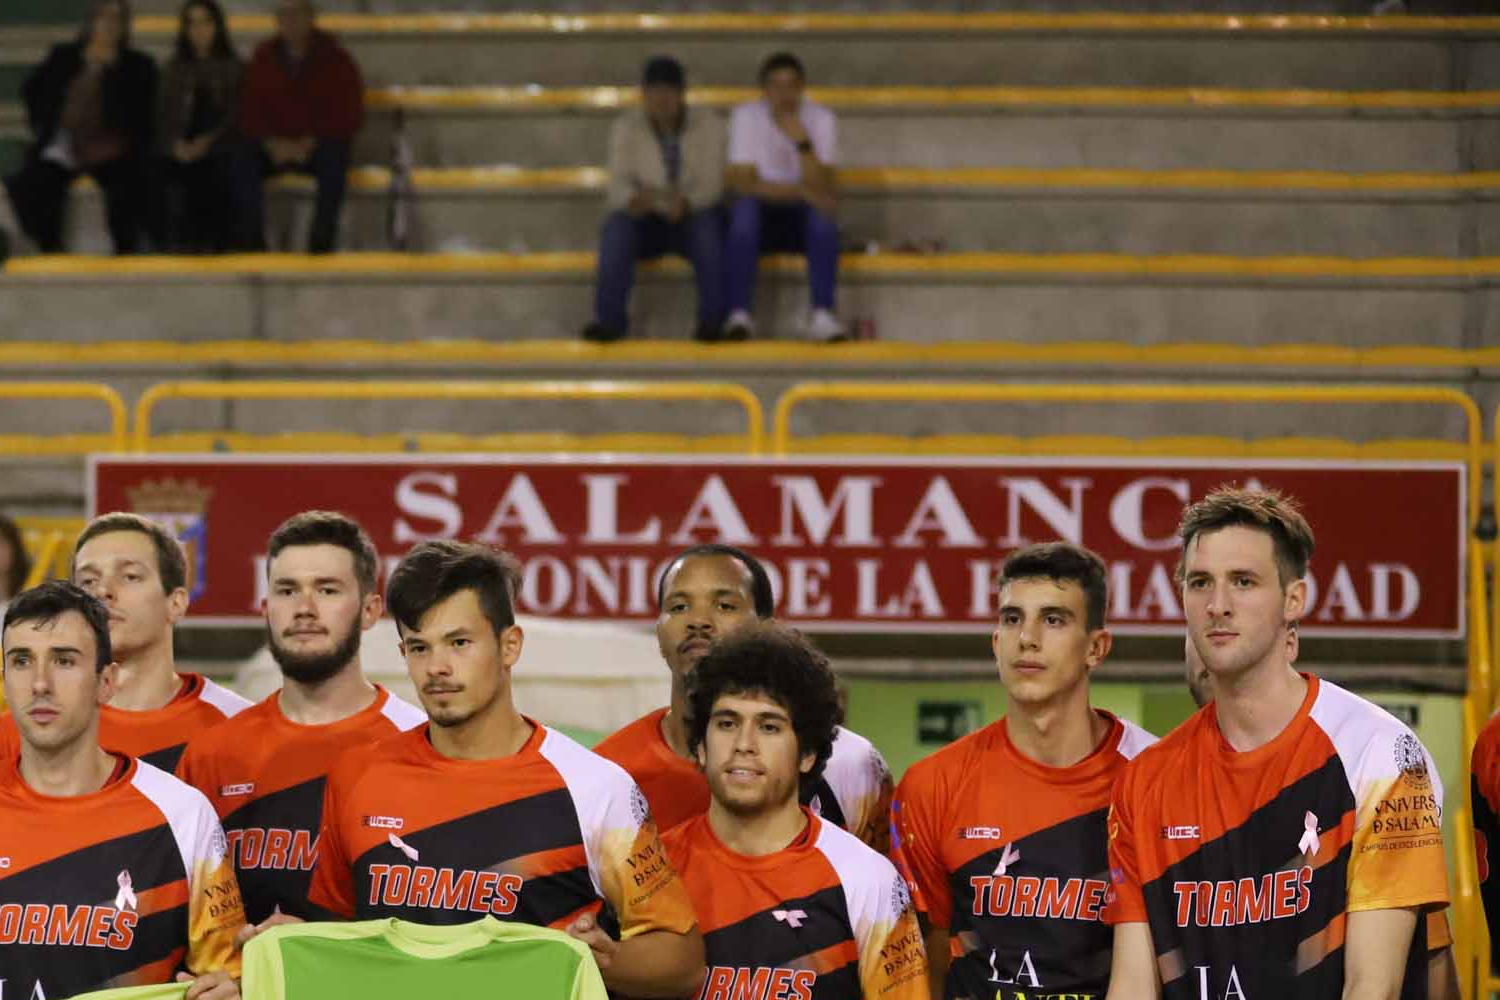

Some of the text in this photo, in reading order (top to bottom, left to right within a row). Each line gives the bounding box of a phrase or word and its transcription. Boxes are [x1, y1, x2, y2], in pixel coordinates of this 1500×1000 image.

[392, 471, 1269, 547] SALAMANC
[855, 558, 947, 616] LA
[226, 827, 321, 871] TORM
[368, 864, 523, 915] TORMES
[1172, 865, 1315, 928] TORMES
[987, 948, 1045, 988] LA
